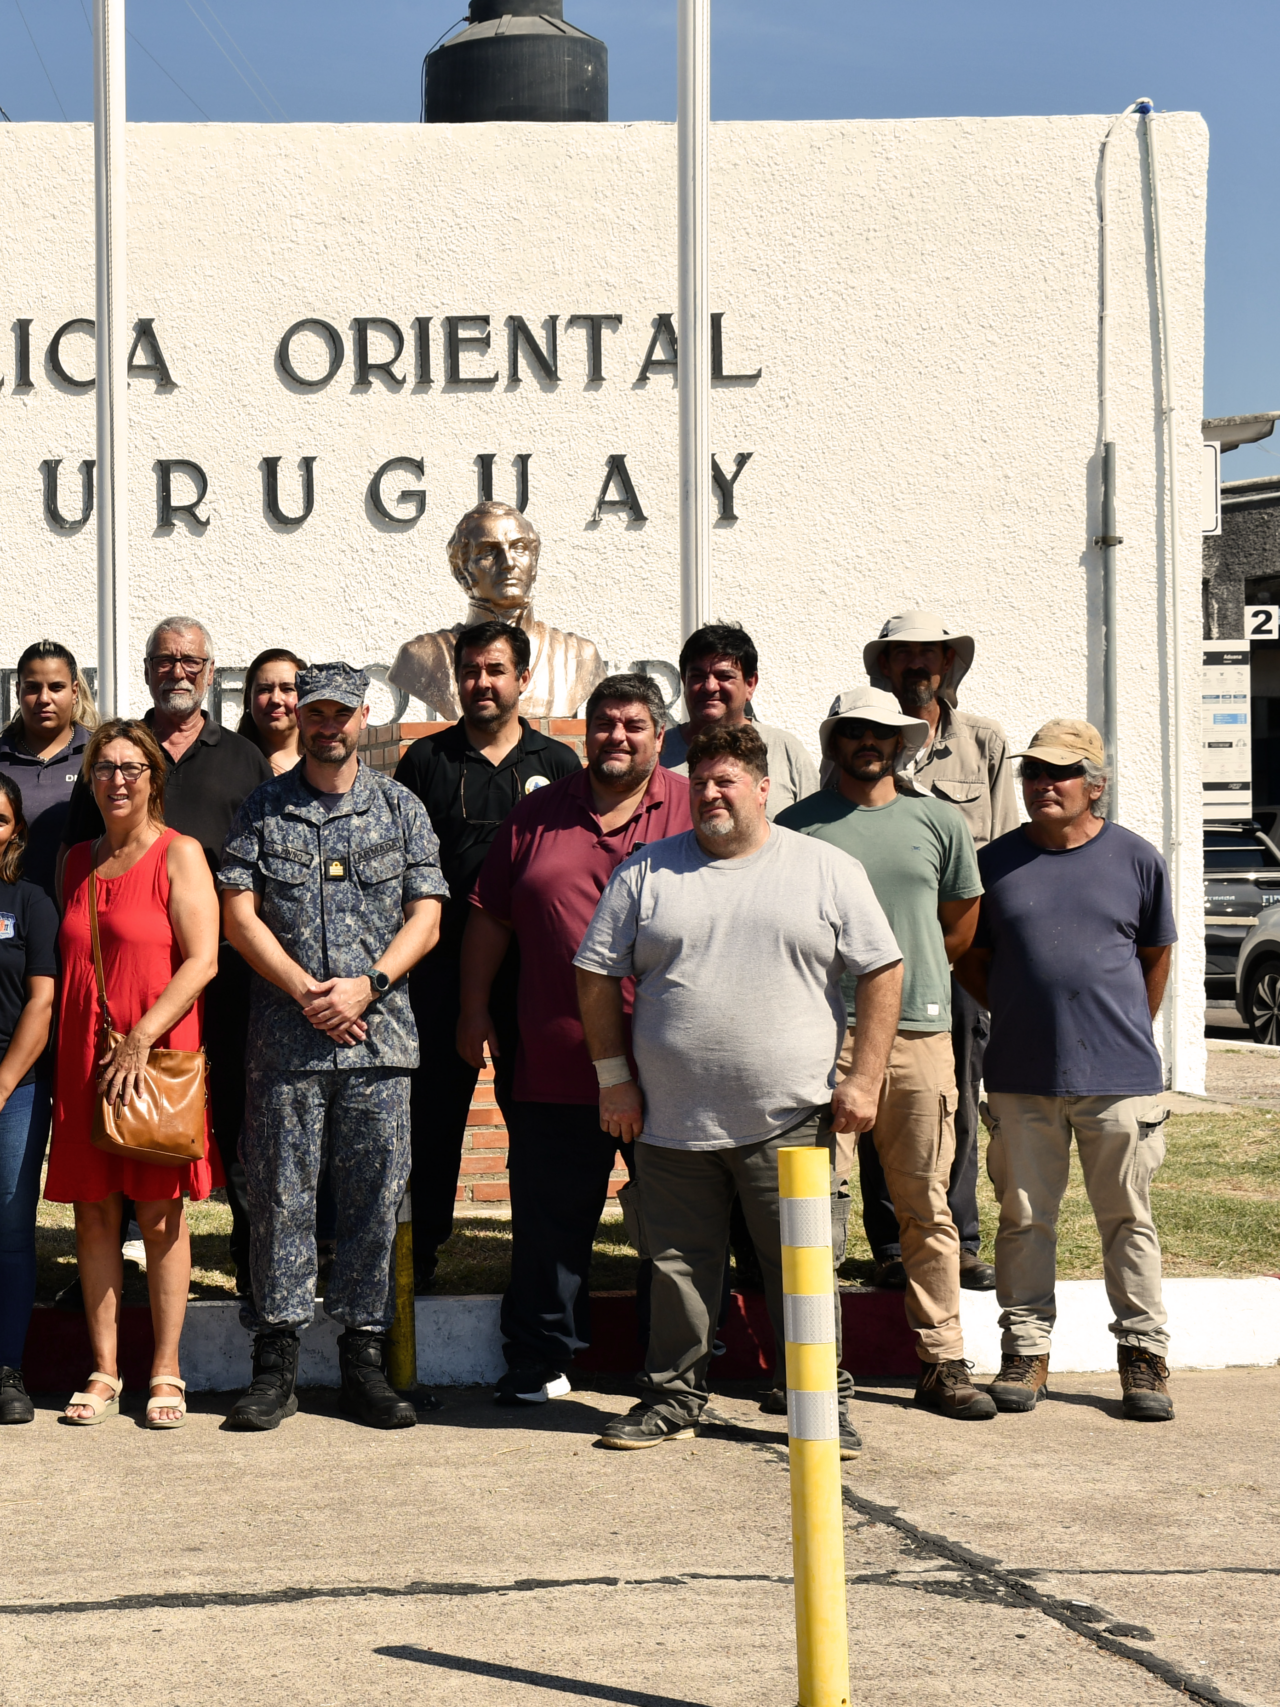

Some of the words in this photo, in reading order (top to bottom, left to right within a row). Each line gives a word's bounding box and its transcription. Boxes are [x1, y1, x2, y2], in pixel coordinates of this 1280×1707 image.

[278, 312, 762, 386] ORIENTAL
[42, 452, 755, 528] URUGUAY
[1251, 609, 1273, 635] 2
[357, 842, 398, 861] ARMADA
